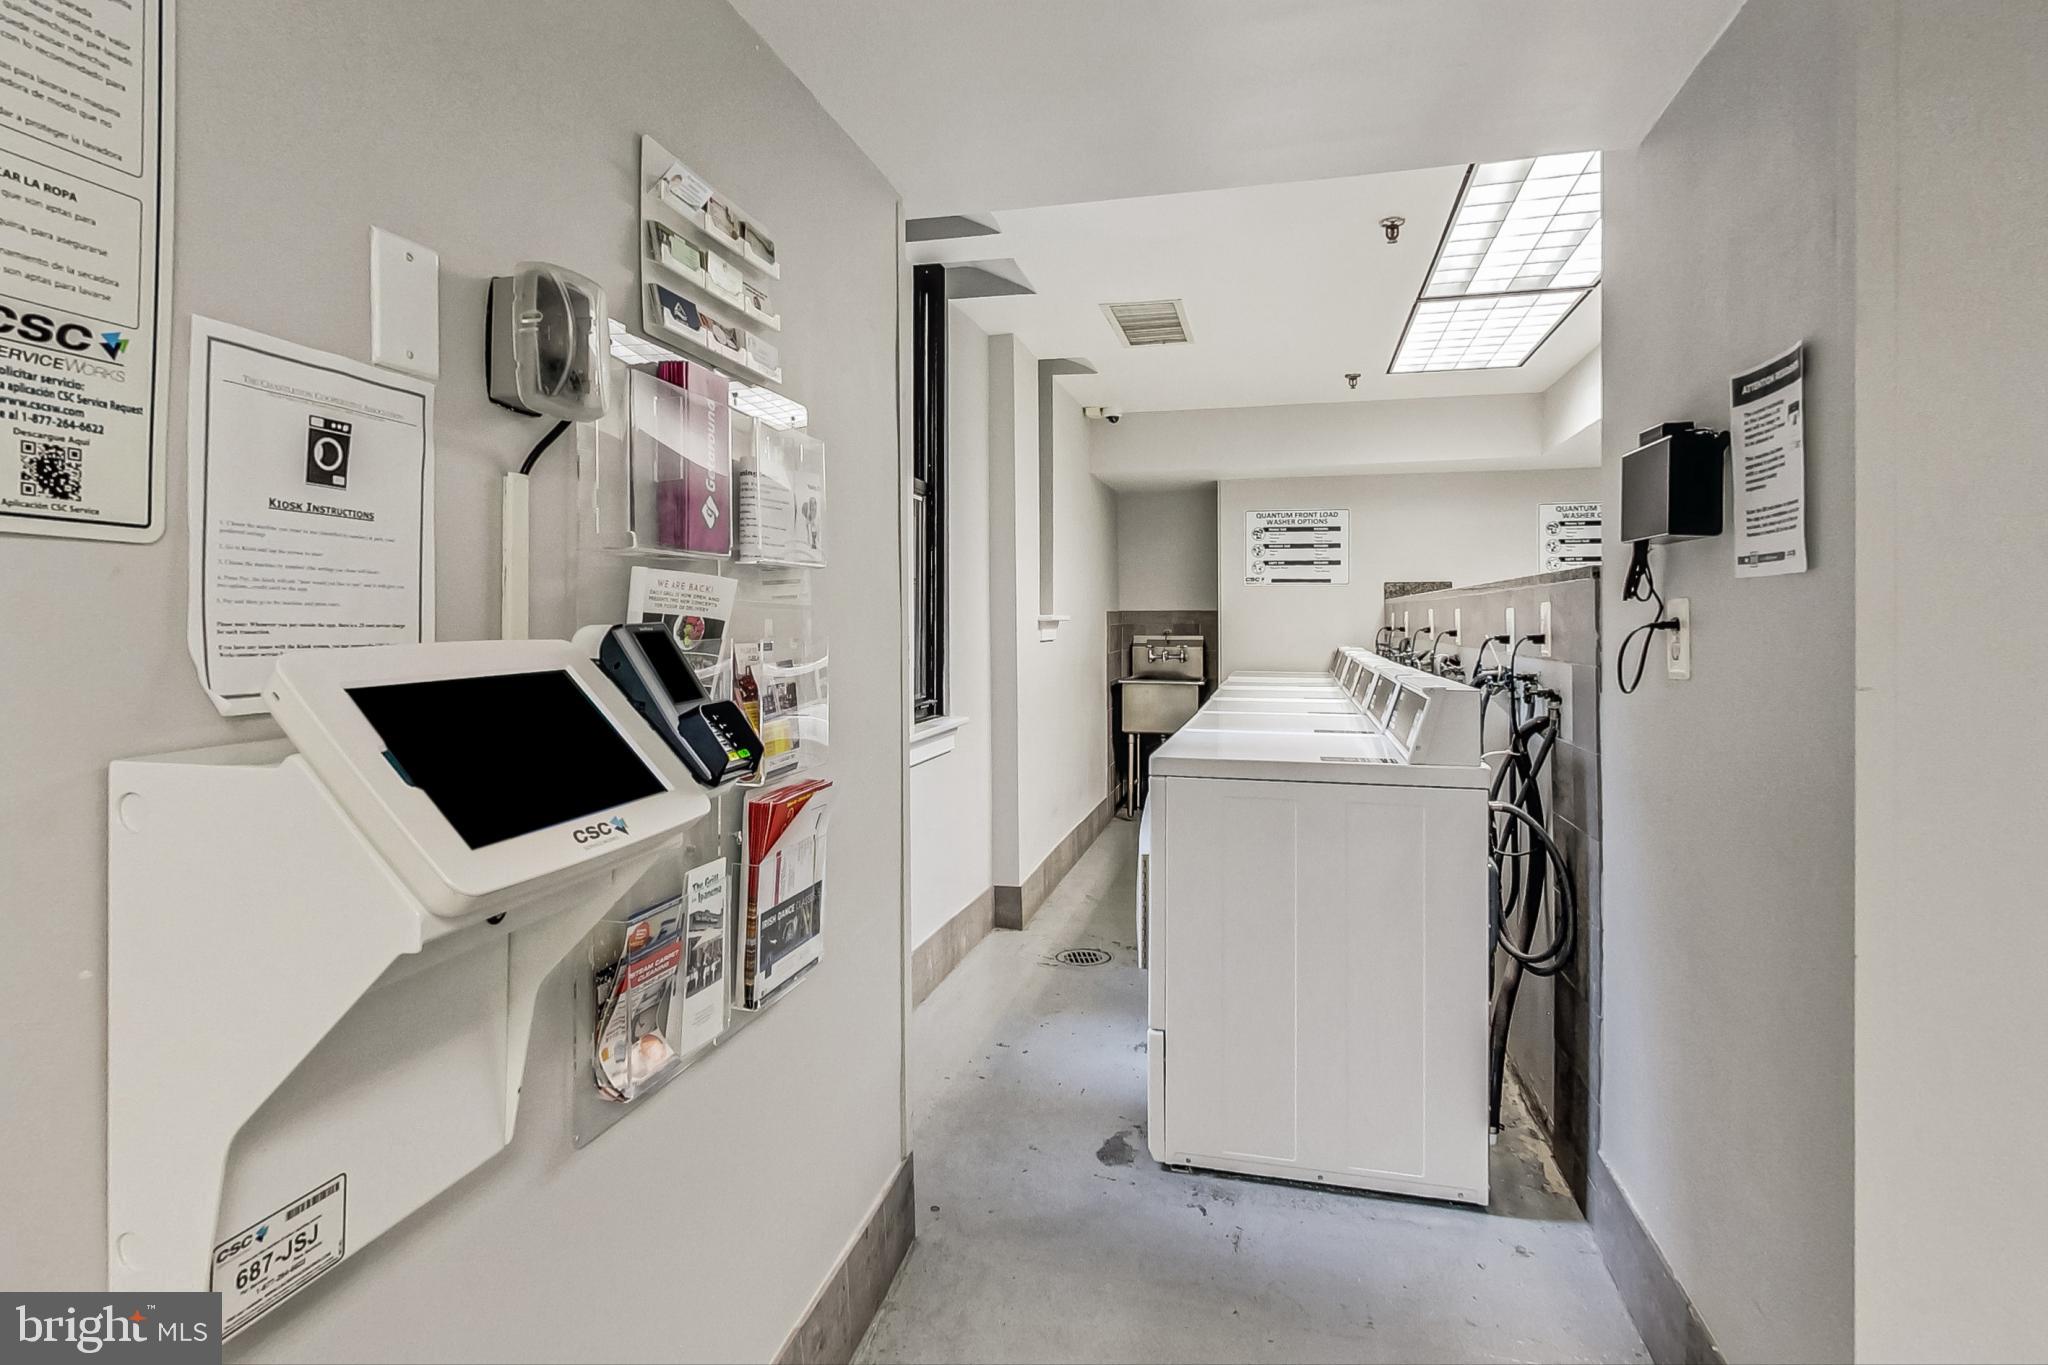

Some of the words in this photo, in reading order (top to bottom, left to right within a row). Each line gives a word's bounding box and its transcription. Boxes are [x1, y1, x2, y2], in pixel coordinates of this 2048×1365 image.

[24, 176, 40, 190] LA
[43, 183, 78, 203] ROPA
[57, 390, 76, 403] CSC
[77, 394, 108, 409] Service
[110, 400, 144, 415] Request
[13, 427, 66, 443] Descargue
[22, 411, 105, 435] 1-877-264-6622
[51, 503, 68, 513] CSC
[69, 505, 100, 516] Service
[268, 497, 303, 511] KIOSK
[306, 502, 375, 521] INSTRUCTIONS
[573, 822, 612, 844] CSC
[216, 1235, 253, 1264] CSC
[236, 1224, 319, 1290] 687-JSJ
